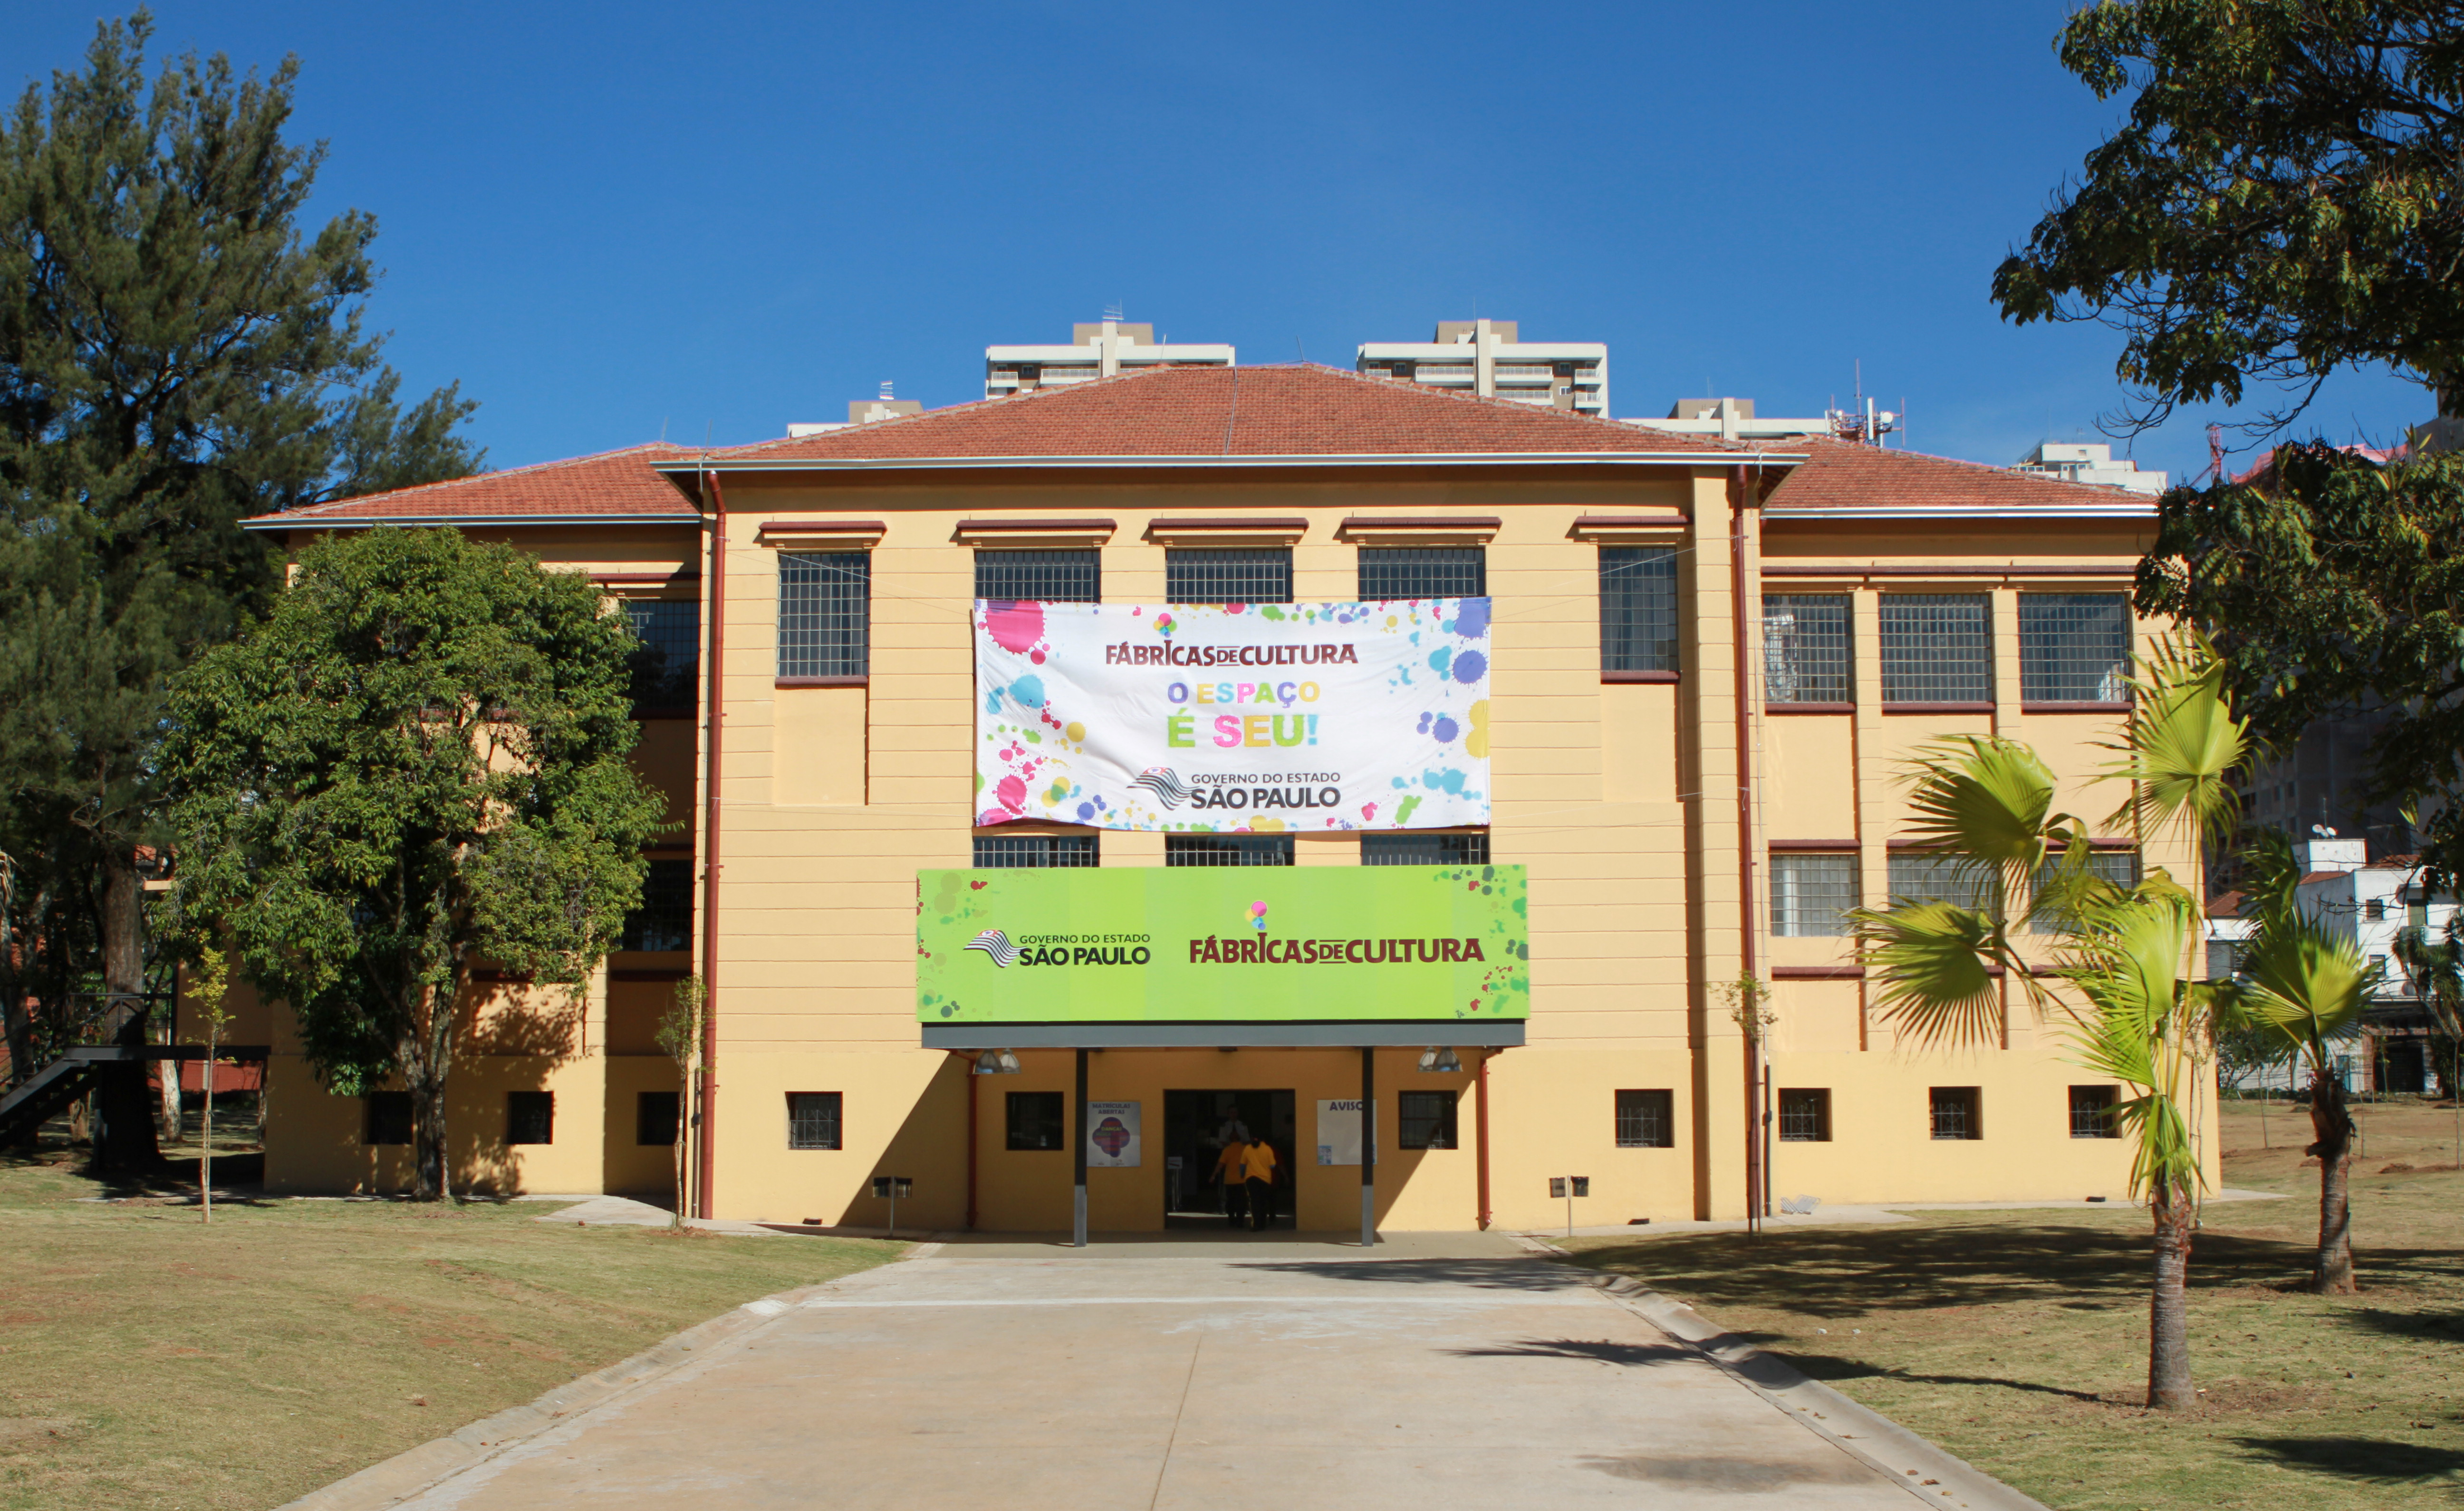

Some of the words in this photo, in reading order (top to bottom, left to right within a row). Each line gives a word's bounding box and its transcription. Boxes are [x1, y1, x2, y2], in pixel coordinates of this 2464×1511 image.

[1106, 640, 1216, 666] FÁBRICAS
[1216, 649, 1238, 664] DE
[1239, 643, 1359, 666] CULTURA
[1167, 682, 1188, 704] O
[1197, 681, 1320, 708] ESPAÇO
[1167, 708, 1195, 747] É
[1213, 714, 1319, 747] SEU!
[1191, 774, 1258, 784] GOVERNO
[1262, 774, 1283, 783] DO
[1287, 773, 1341, 783] ESTADO
[1191, 784, 1248, 809] SÃO
[1252, 787, 1341, 808] PAULO
[1020, 935, 1078, 944] GOVERNO
[1082, 935, 1100, 943] DO
[1103, 934, 1151, 943] ESTADO
[1190, 932, 1319, 964] FÁBRICAS
[1319, 944, 1344, 960] DE
[1346, 938, 1486, 963] CULTURA
[1020, 944, 1069, 966] SÃO
[1073, 946, 1151, 966] PAULO
